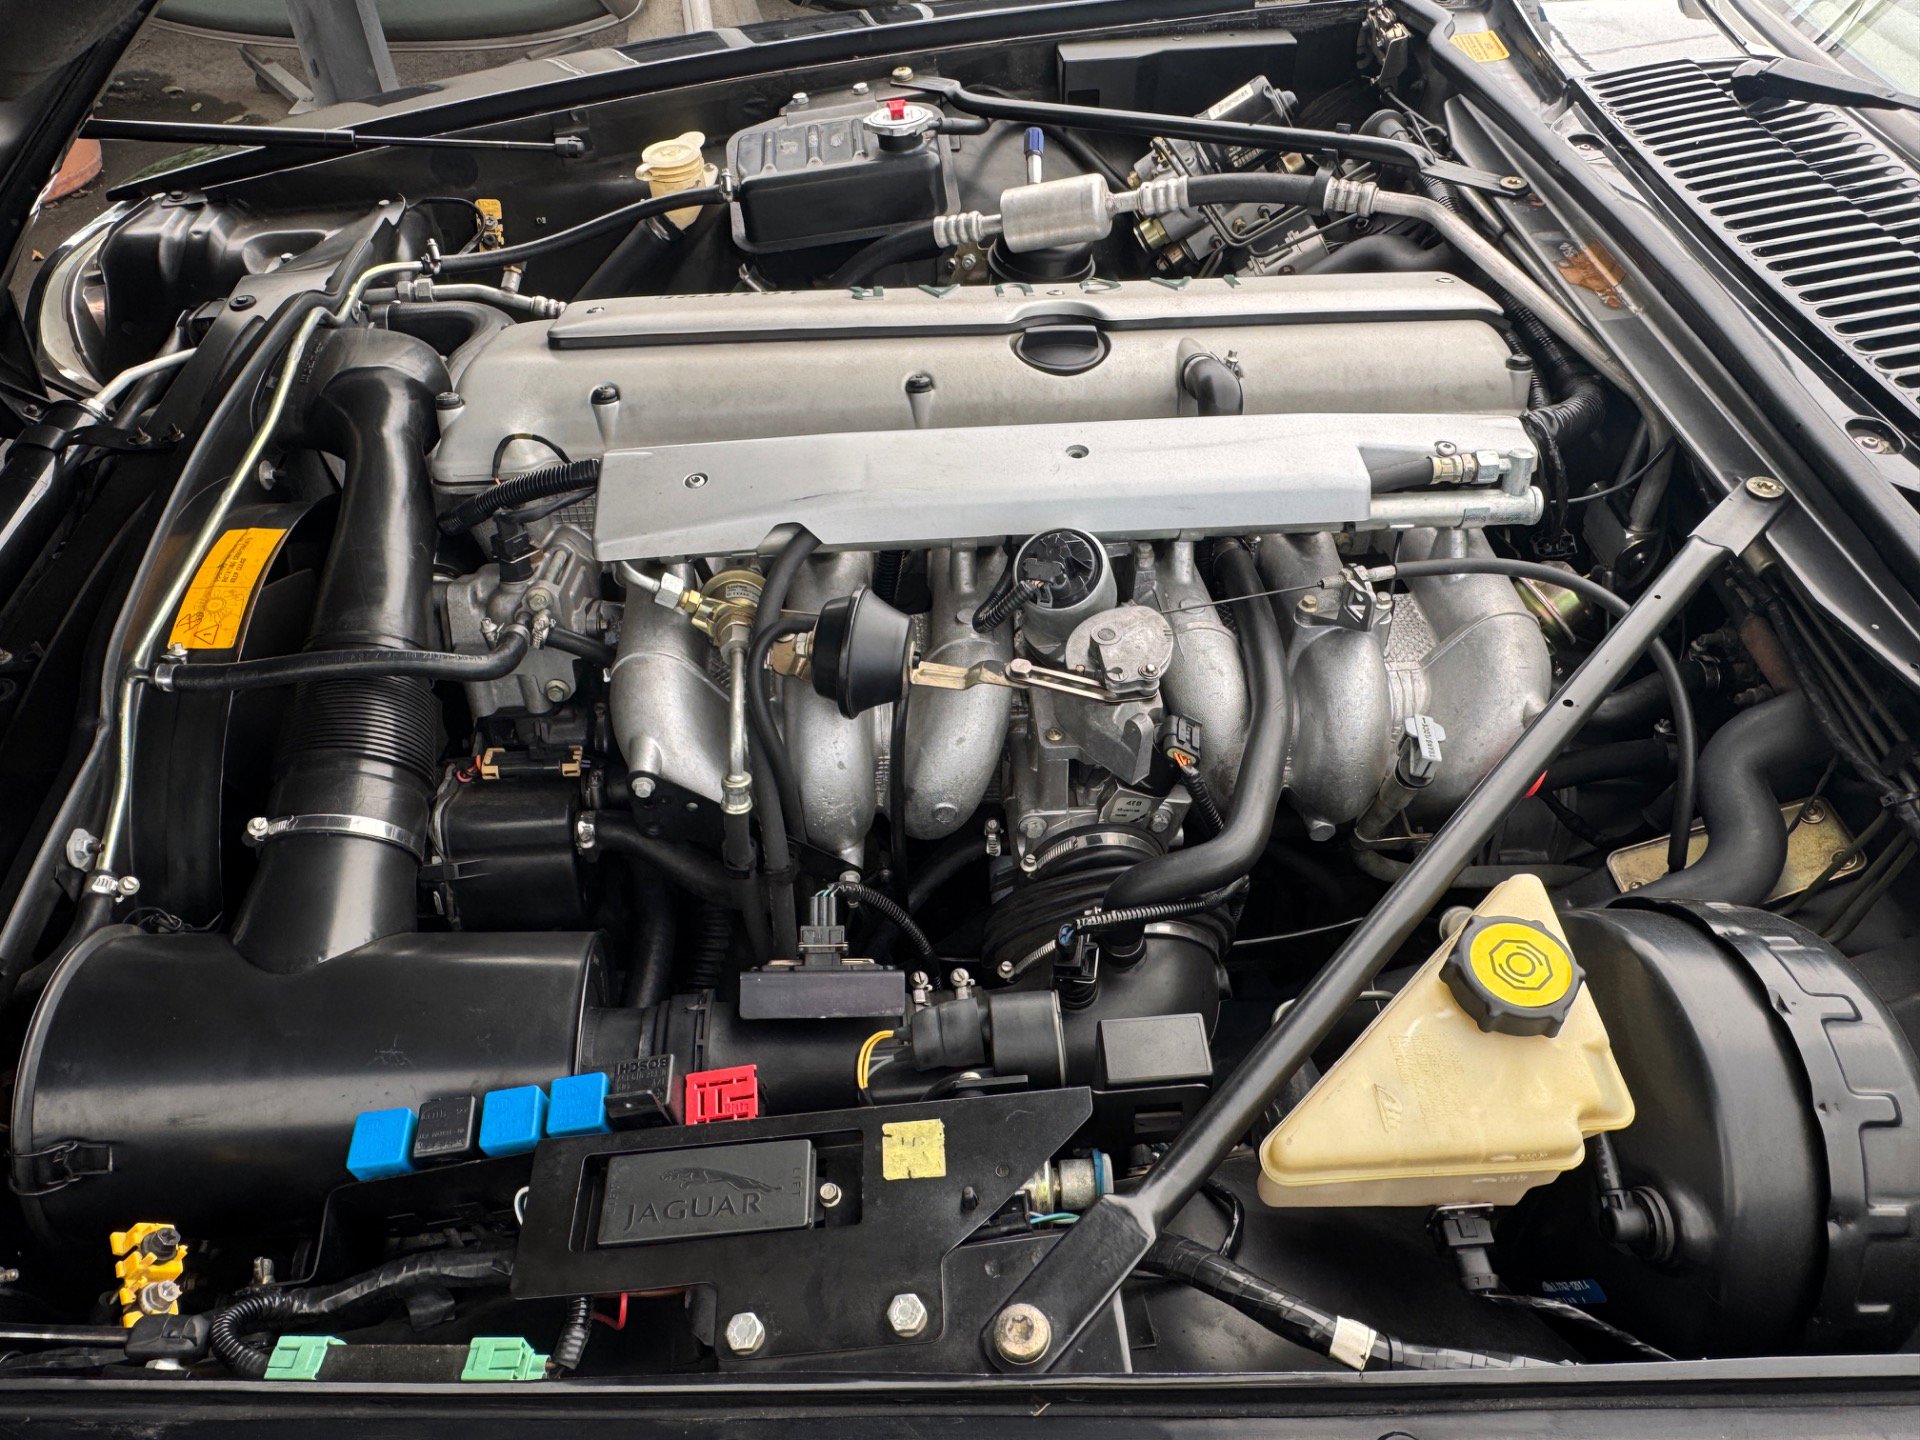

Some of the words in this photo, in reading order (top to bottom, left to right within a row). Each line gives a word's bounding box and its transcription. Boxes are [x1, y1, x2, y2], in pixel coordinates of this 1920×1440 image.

[615, 1057, 668, 1076] BOSCH
[791, 1167, 802, 1198] LIFT
[624, 1192, 762, 1233] JAGUAR
